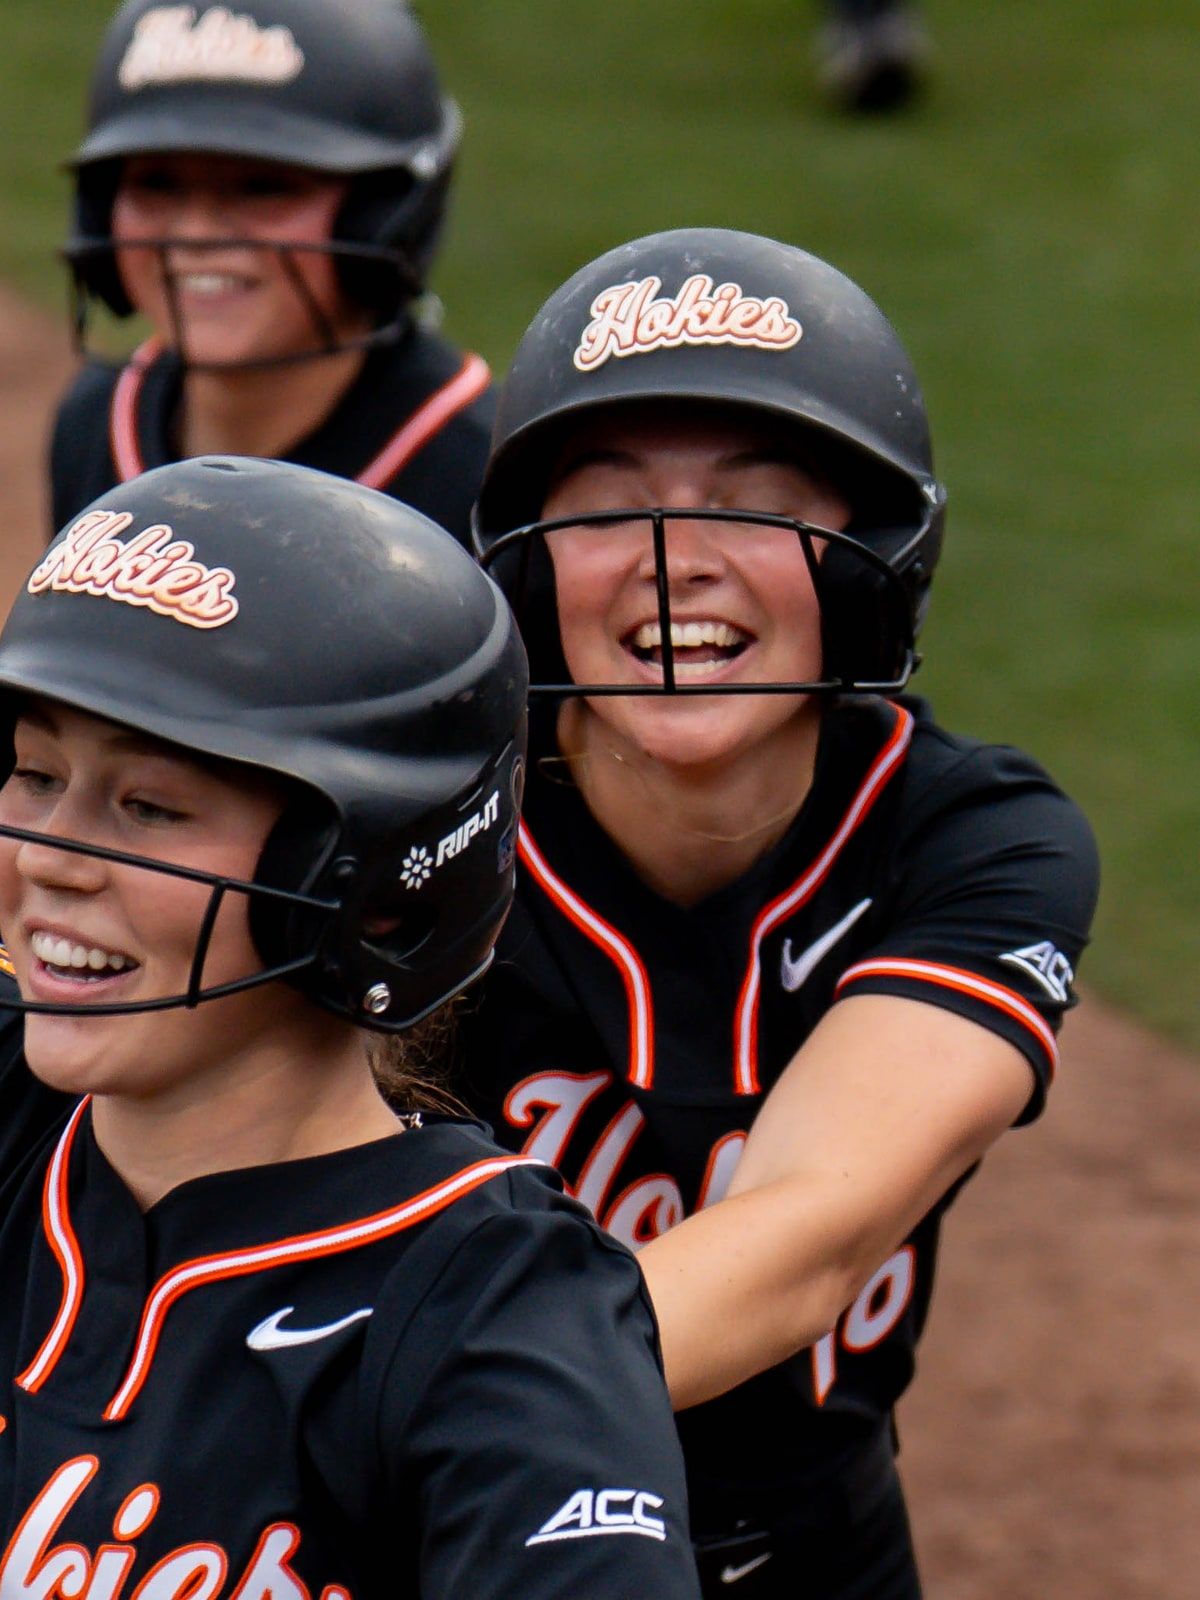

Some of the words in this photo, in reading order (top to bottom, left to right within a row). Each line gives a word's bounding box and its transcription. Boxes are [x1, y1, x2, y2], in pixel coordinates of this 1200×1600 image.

[574, 274, 803, 371] Hokies
[28, 510, 239, 629] Hokies
[527, 1489, 666, 1545] ACC
